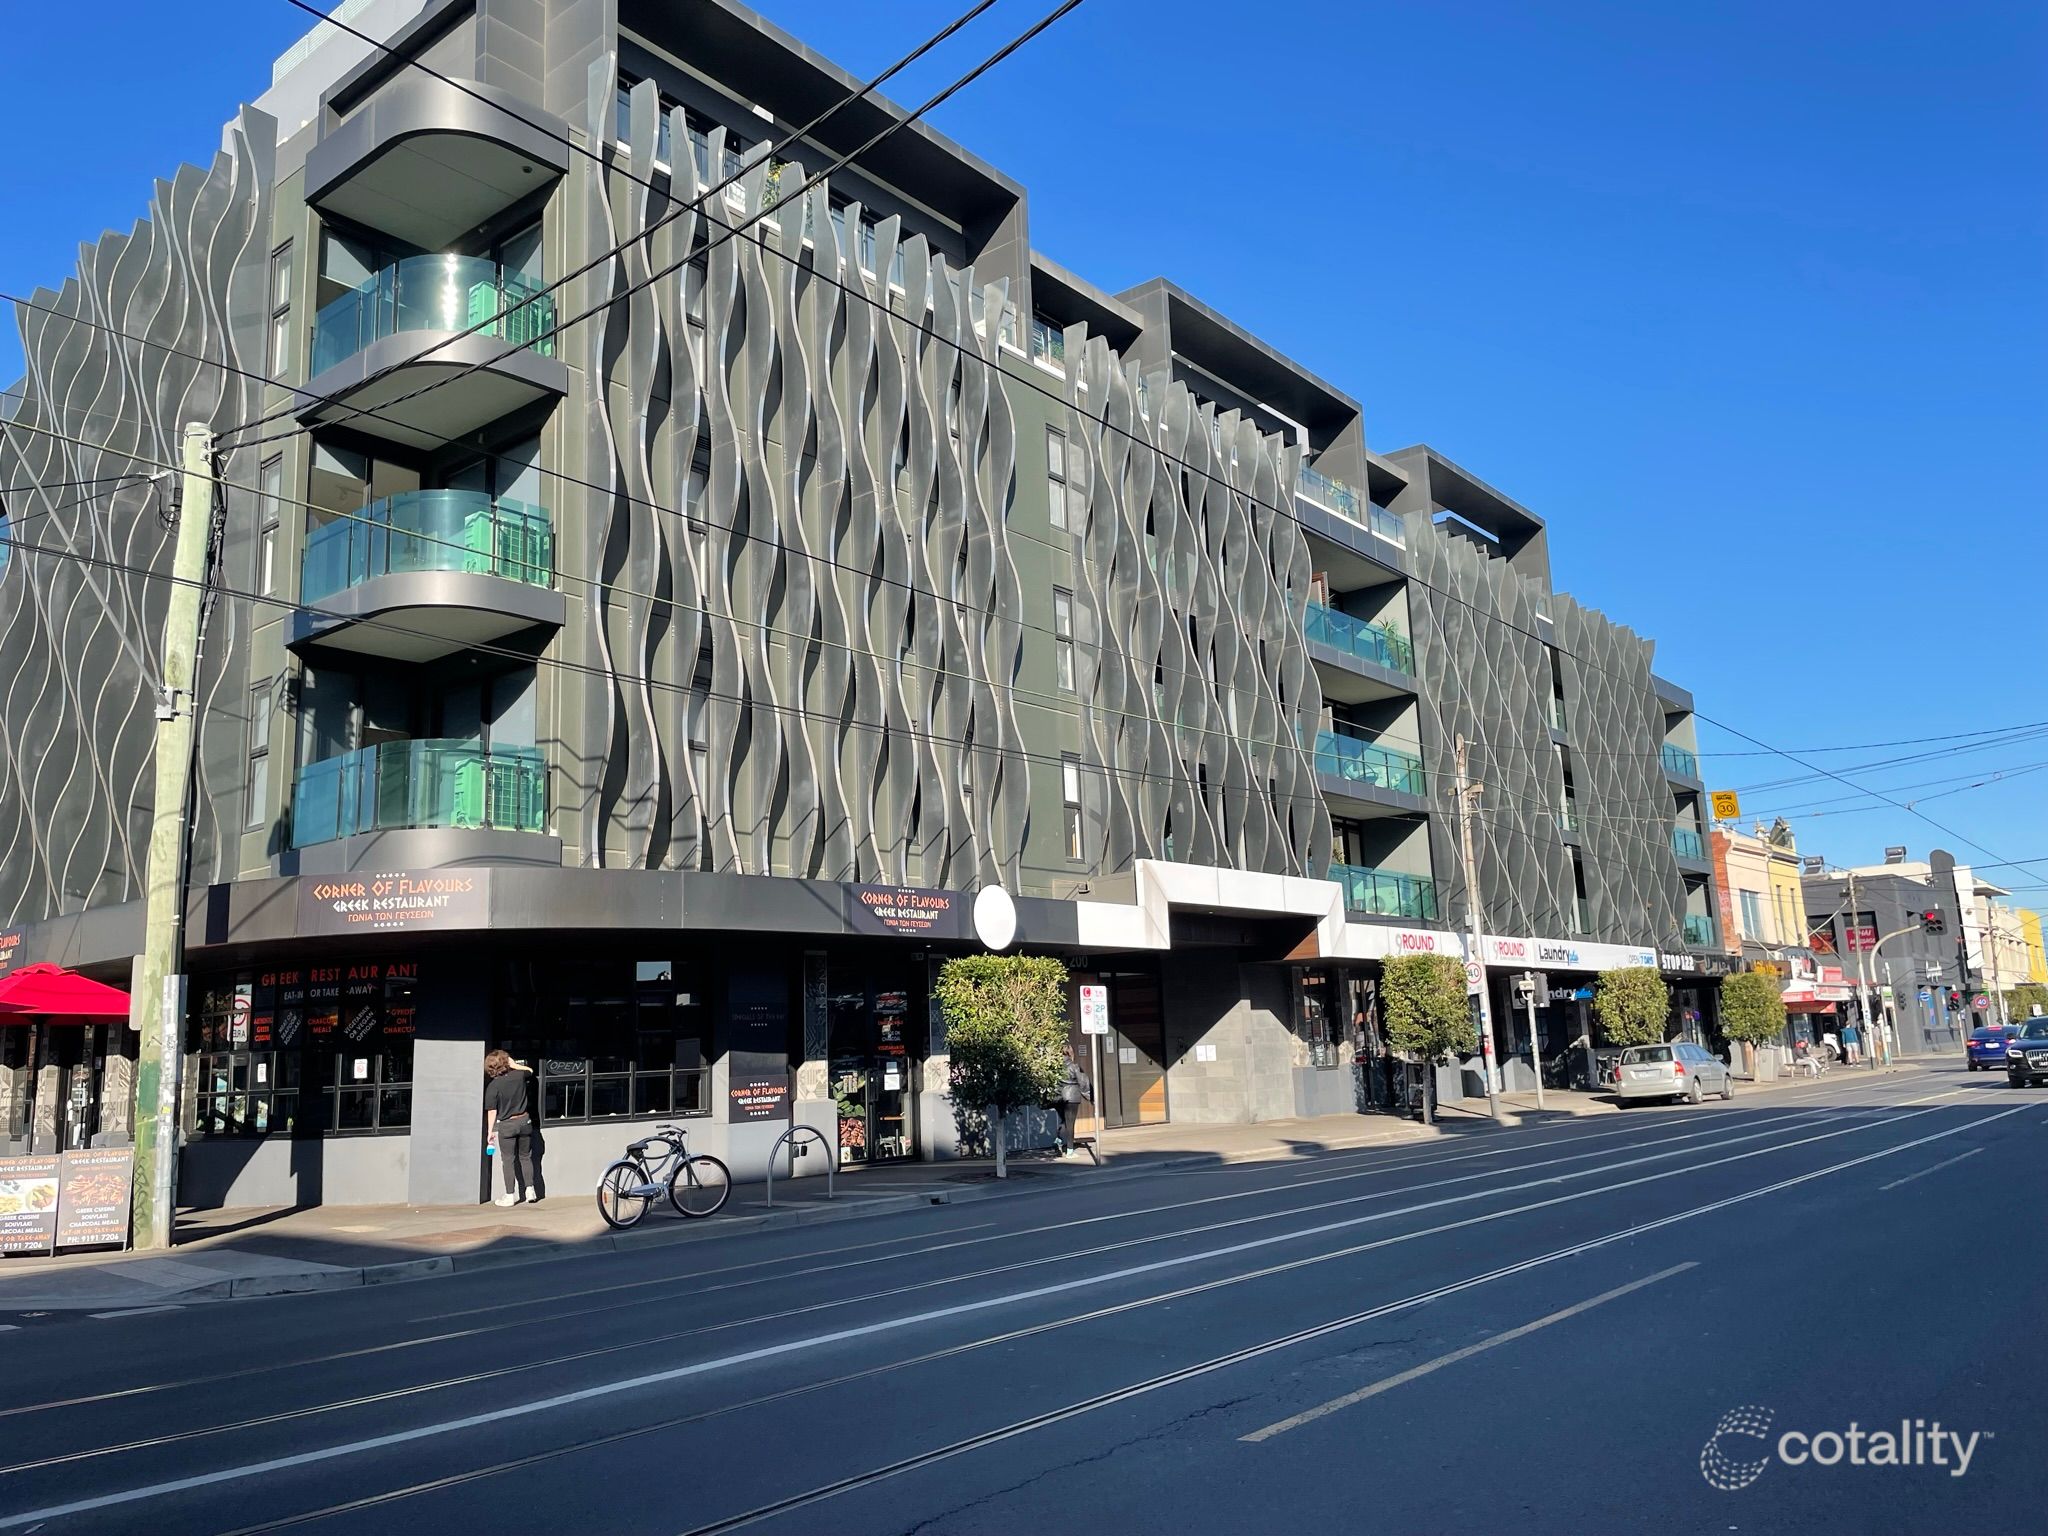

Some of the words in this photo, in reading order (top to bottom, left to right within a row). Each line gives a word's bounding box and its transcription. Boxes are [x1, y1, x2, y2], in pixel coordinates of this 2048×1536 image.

[1719, 804, 1733, 813] 30
[313, 883, 365, 900] CORNER
[371, 880, 394, 897] OF
[399, 878, 473, 895] FLAVOURS
[333, 898, 369, 913] GREEK
[373, 895, 450, 910] RESTAURANT
[861, 891, 894, 905] CORNER
[896, 893, 909, 907] OF
[911, 895, 950, 910] FLAVOURS
[874, 906, 896, 918] GREEK
[897, 908, 939, 920] RESTAURANT
[1538, 943, 1570, 966] Laundry
[1548, 987, 1577, 1001] ndry
[1095, 1004, 1106, 1013] 2P
[549, 1061, 583, 1071] OPEN
[4, 1242, 22, 1250] 9191
[24, 1241, 43, 1249] 7206
